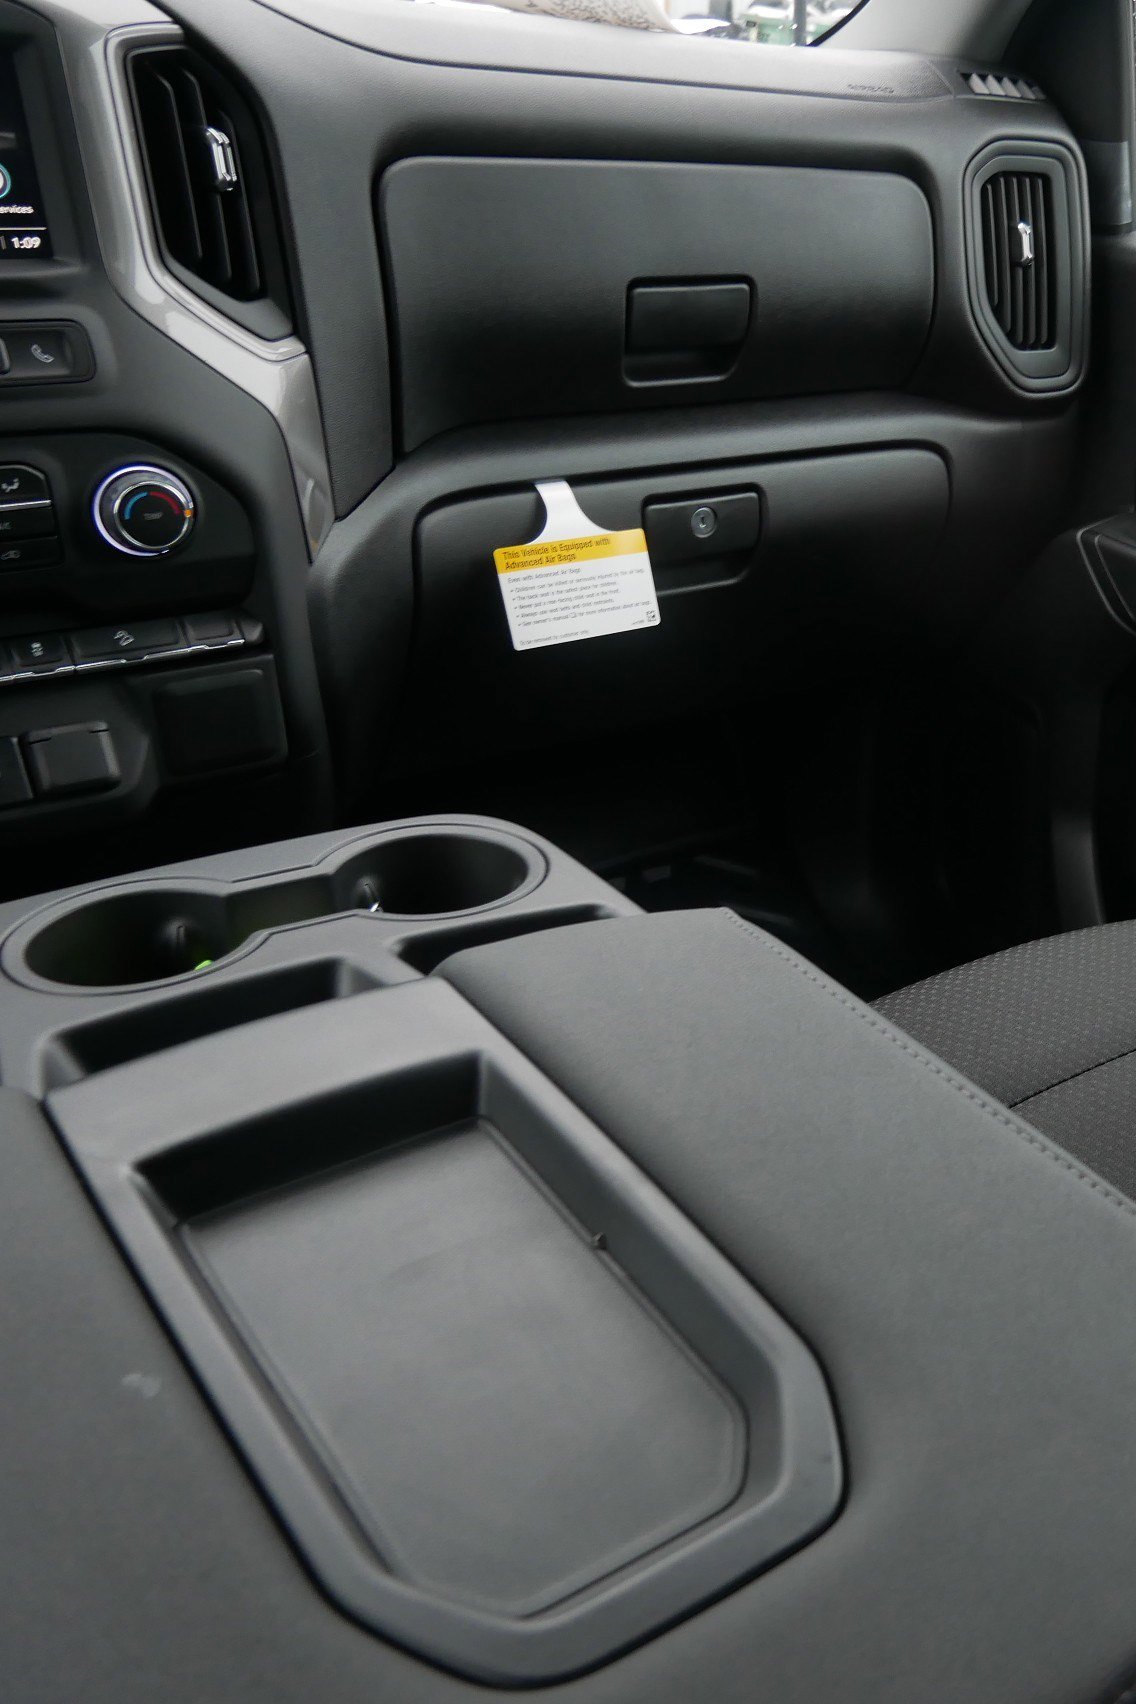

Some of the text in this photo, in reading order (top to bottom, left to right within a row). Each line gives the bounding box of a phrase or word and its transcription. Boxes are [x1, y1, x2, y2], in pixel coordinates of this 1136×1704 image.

[11, 236, 42, 249] 1:09
[503, 552, 519, 560] This
[521, 547, 548, 556] Vehicle
[559, 541, 593, 552] Equipped
[505, 553, 576, 569] Advanced Air Bags
